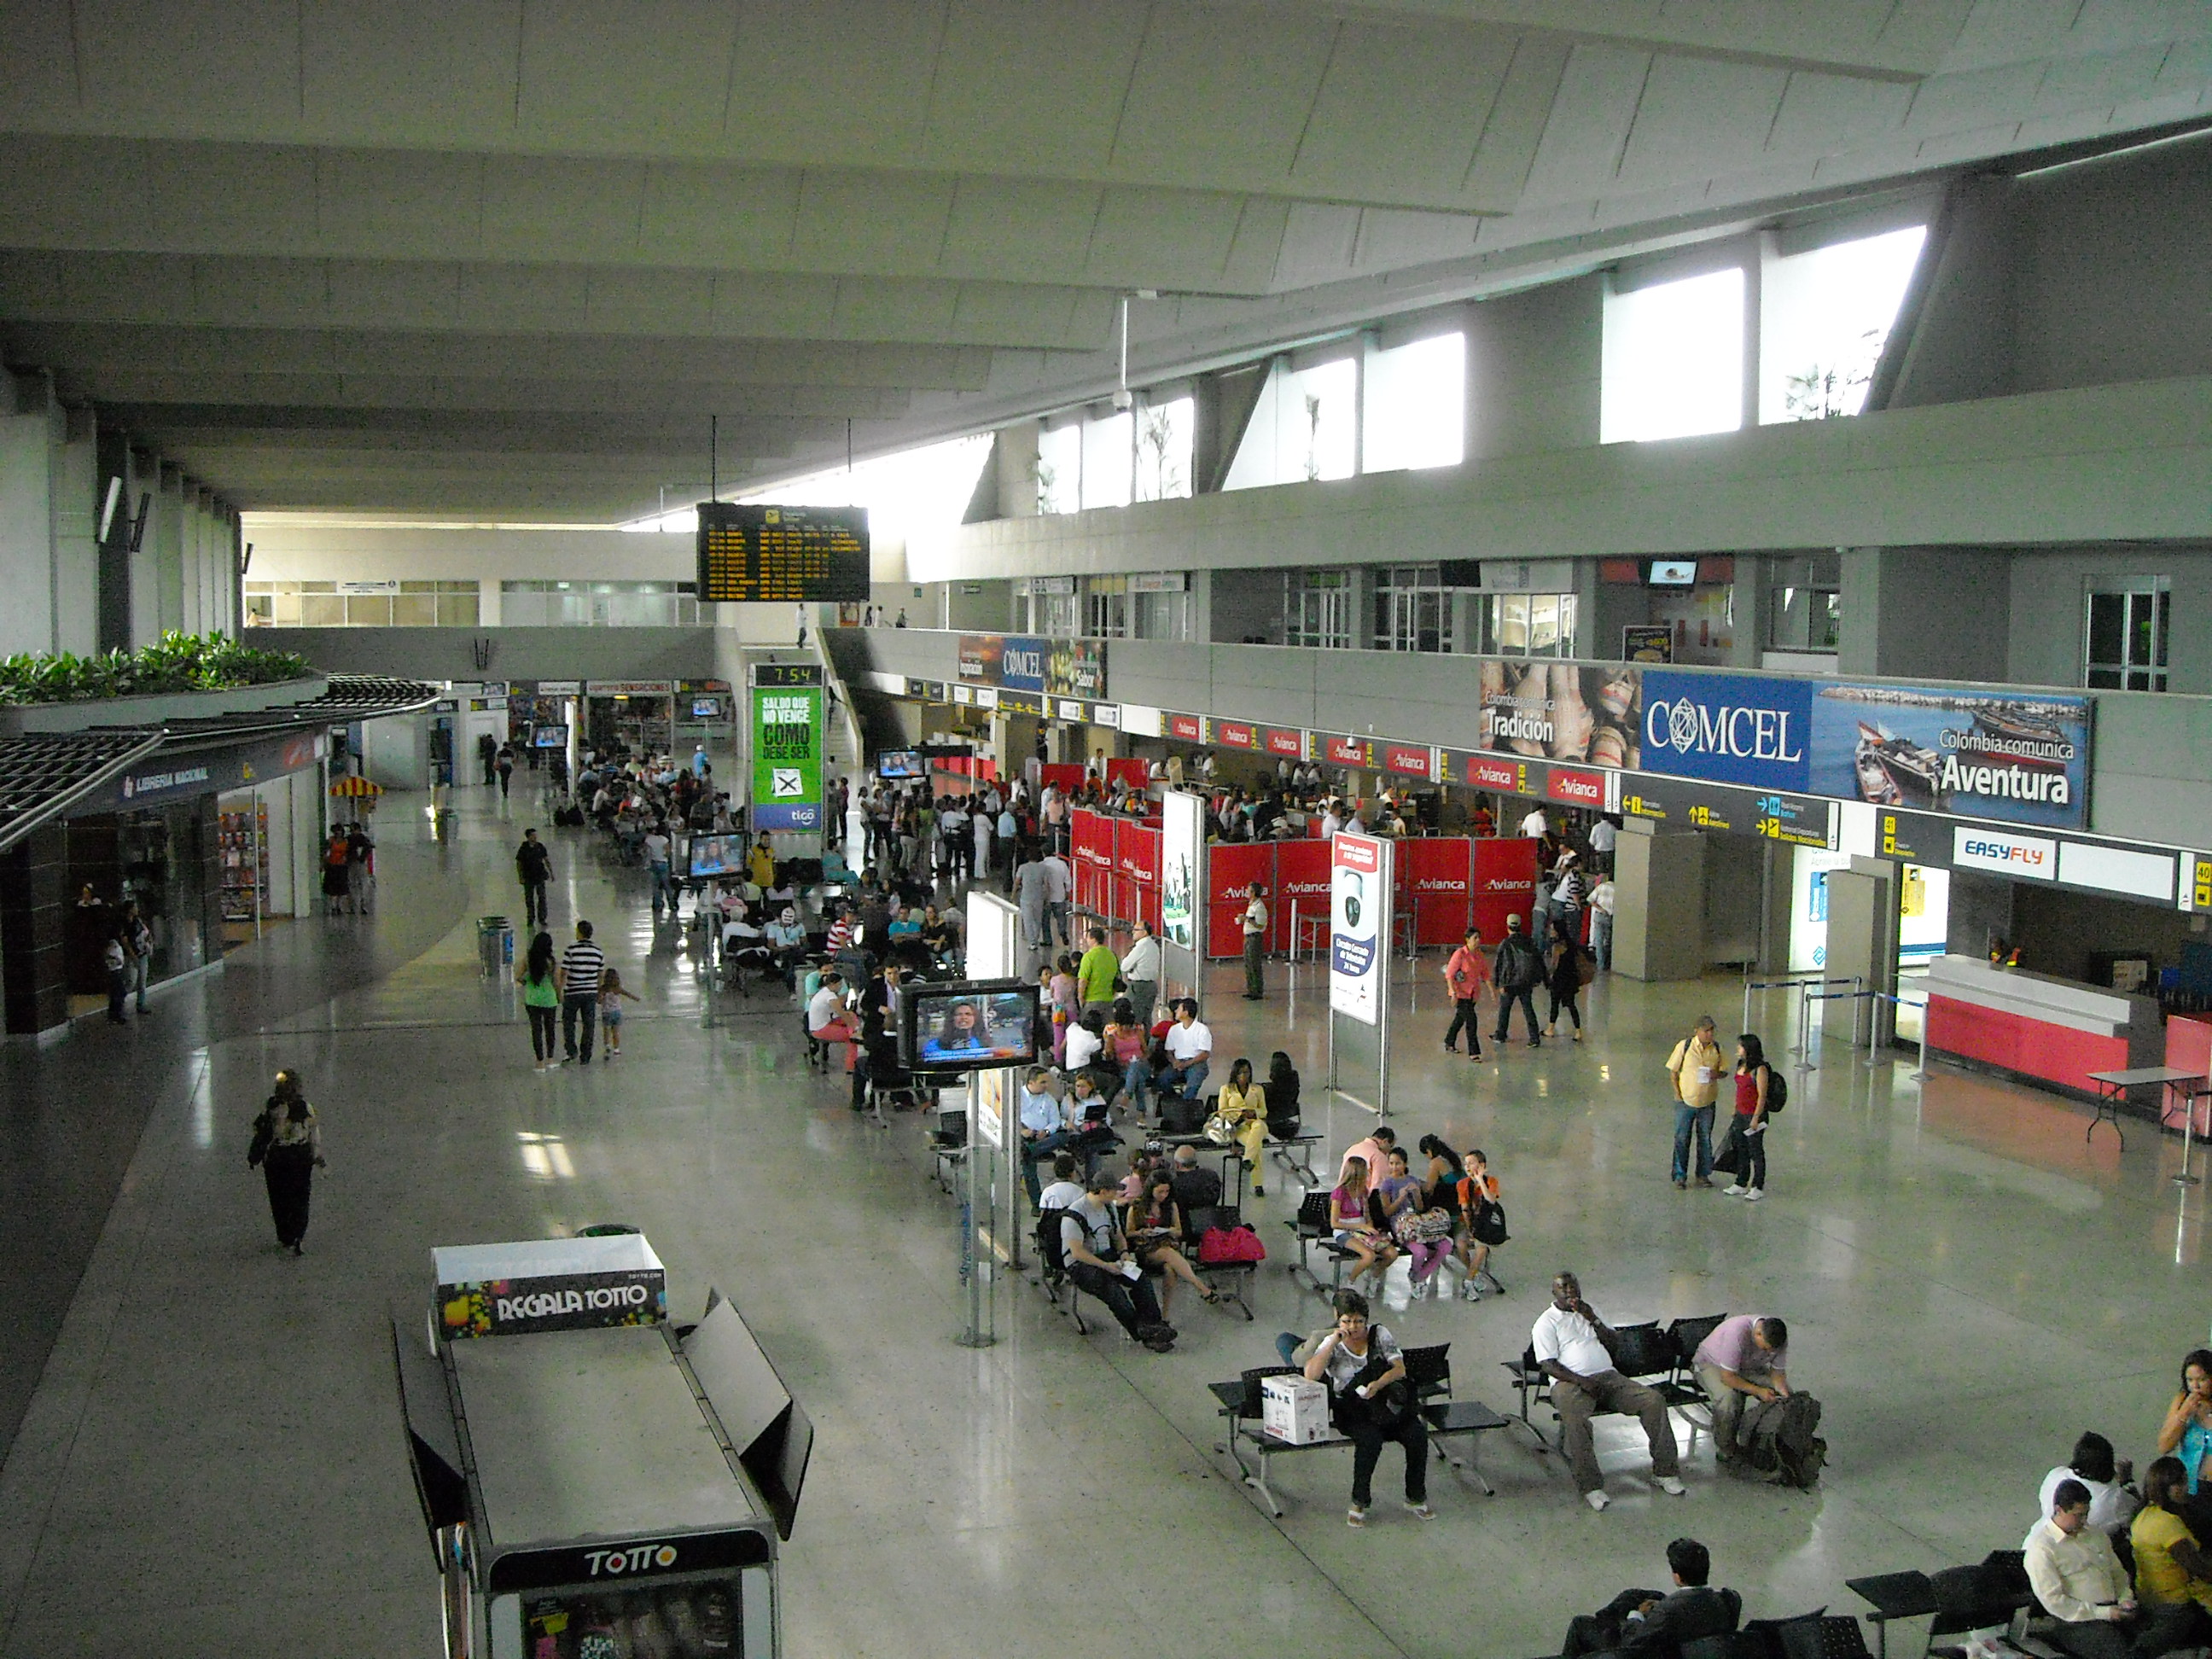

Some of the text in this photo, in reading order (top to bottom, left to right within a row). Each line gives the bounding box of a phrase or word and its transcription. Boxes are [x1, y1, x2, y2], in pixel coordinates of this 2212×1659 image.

[1003, 648, 1042, 678] COMCEL
[792, 696, 810, 709] QUE
[762, 709, 777, 724] NO
[1487, 707, 1554, 742] Tradición
[763, 724, 810, 745] COMO
[1226, 729, 1248, 743] Avianca
[1647, 696, 1802, 763] COMCEL
[1273, 736, 1297, 751] Avianca
[1939, 729, 2074, 760] Colombia comunica
[791, 746, 810, 760] SER
[1335, 745, 1361, 760] Avianca
[1394, 753, 1424, 770] Avianca
[1476, 765, 1511, 784] Avianca
[1940, 754, 2069, 804] Aventura
[1558, 777, 1598, 798] Avianca
[791, 808, 816, 825] tigo
[1965, 840, 2044, 865] EASYFLY
[2197, 866, 2209, 879] 40
[1284, 880, 1331, 894] Avianca
[1416, 877, 1465, 890] Avianca
[1487, 878, 1531, 890] Avianca
[497, 1284, 648, 1322] REGALA TOTTO
[584, 1544, 678, 1576] TOTTO
